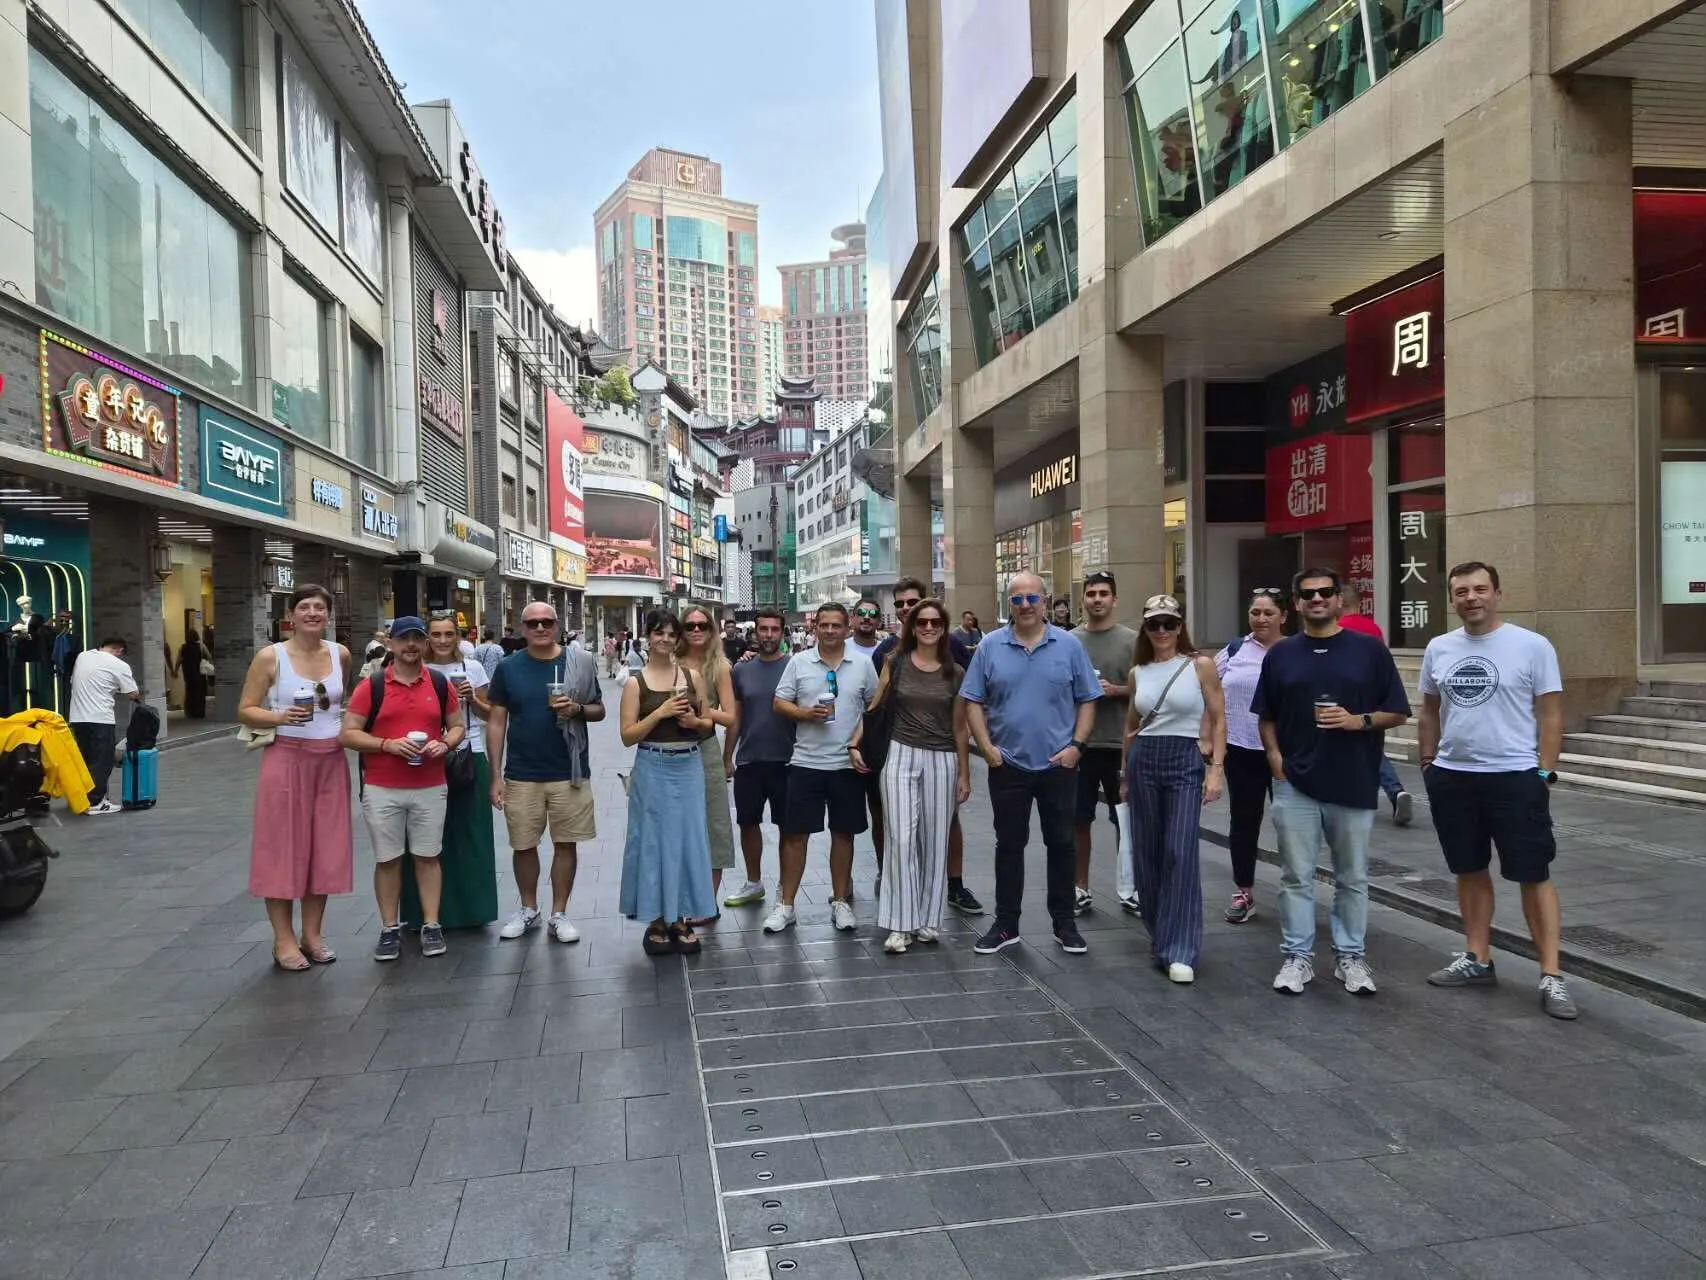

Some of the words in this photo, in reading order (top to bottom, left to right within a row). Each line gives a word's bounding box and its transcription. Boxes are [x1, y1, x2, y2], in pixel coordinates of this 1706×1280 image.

[1392, 311, 1431, 376] 周
[80, 385, 168, 444] 童年记忆
[1291, 393, 1308, 417] YH
[105, 426, 144, 460] 杂货铺
[1290, 443, 1327, 479] 出清
[1030, 455, 1076, 497] HUAWEI
[1288, 481, 1327, 517] 折扣
[1662, 522, 1689, 530] CHOW
